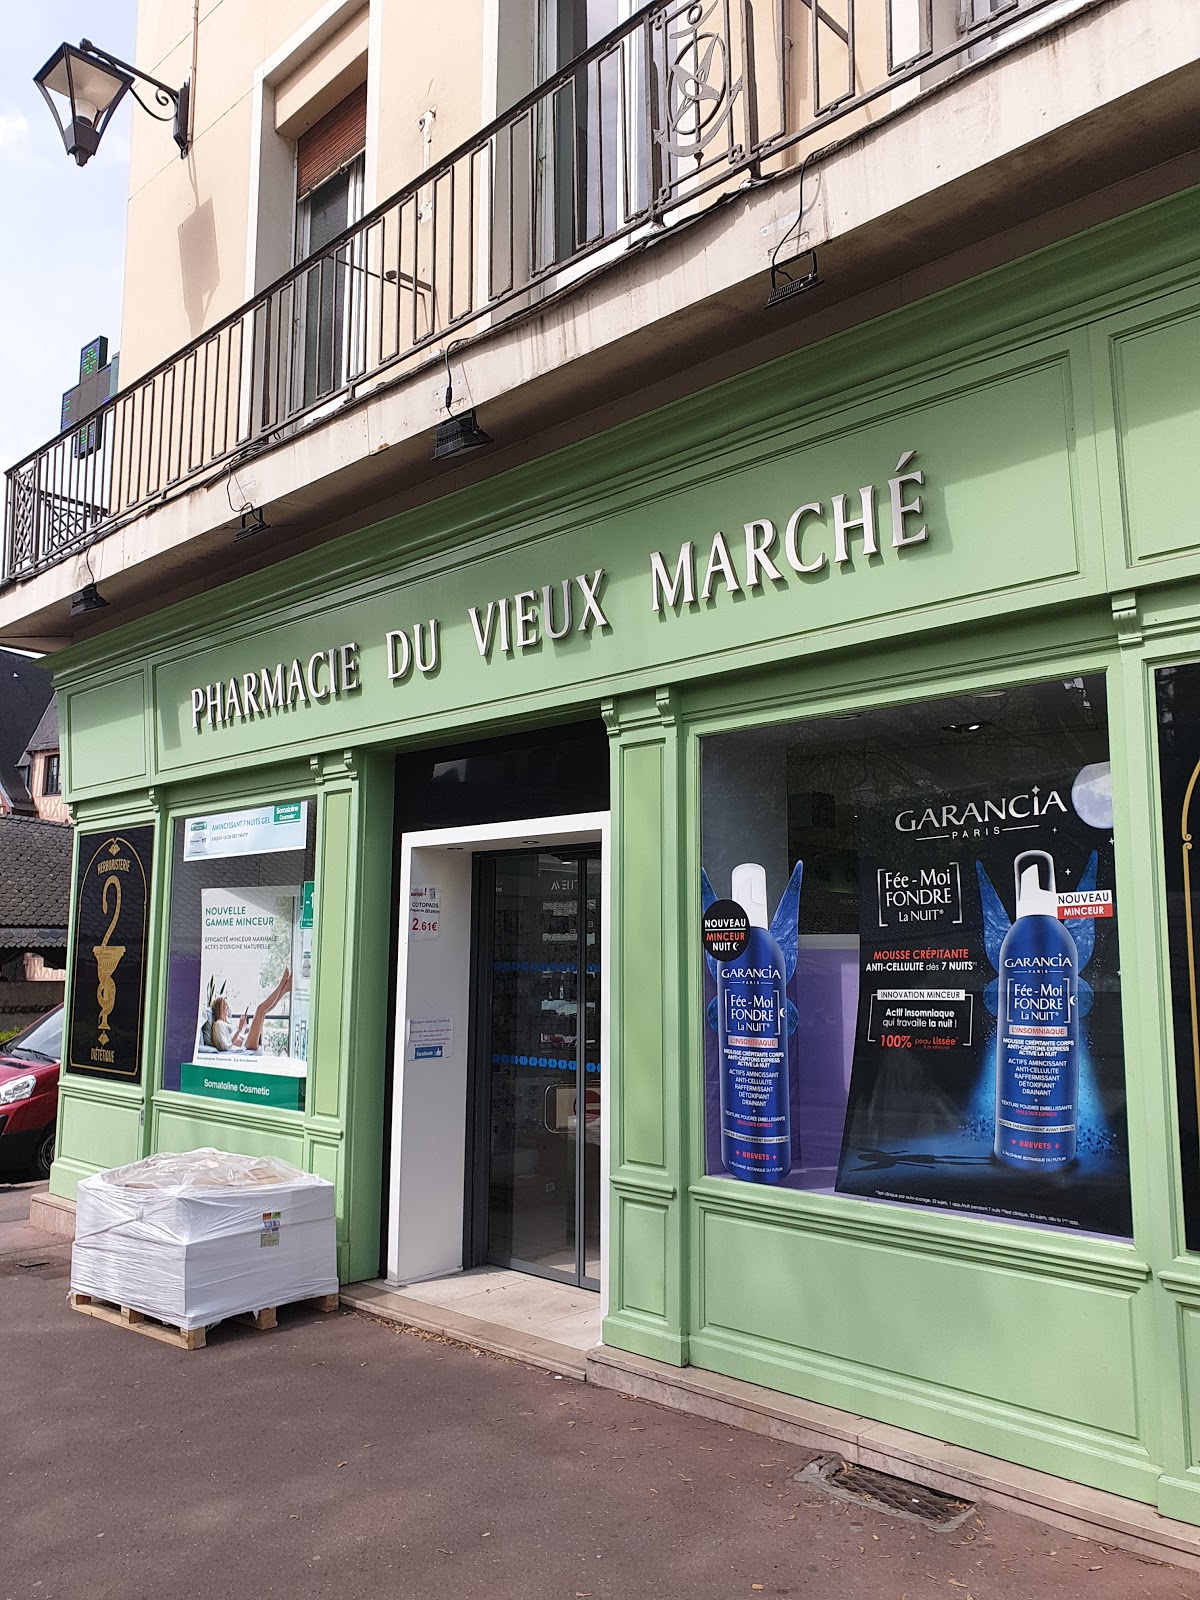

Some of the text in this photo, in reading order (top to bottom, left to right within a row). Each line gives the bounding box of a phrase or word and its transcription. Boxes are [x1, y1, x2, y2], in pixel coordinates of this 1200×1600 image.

[190, 449, 929, 729] PHARMACIE DU VIEUX MARCHÉ
[261, 816, 271, 825] GEL
[951, 825, 1001, 839] PARIS
[885, 887, 952, 908] FONDRE
[1057, 892, 1109, 904] NOUVEAU
[205, 906, 246, 916] NOUVELLE
[1063, 906, 1105, 916] MINCEUR
[205, 917, 274, 927] GAMME MINCEUR
[412, 918, 438, 931] 2.61€
[704, 918, 746, 928] NOUVEAU
[706, 932, 745, 941] MINCEUR
[712, 942, 730, 951] NUIT
[873, 947, 969, 961] MOUSSE CRÉPITANTE
[865, 962, 924, 971] ANTI-CELLULITE
[925, 962, 939, 971] dès
[941, 962, 947, 970] 7
[880, 991, 961, 999] INNOVATION MINCEUR
[1014, 998, 1063, 1010] FONDRE
[731, 1009, 774, 1022] FONDRE
[885, 1008, 955, 1019] Actif insomniaque
[882, 1018, 895, 1028] qui
[896, 1018, 927, 1027] travaille
[928, 1019, 937, 1028] la
[938, 1019, 953, 1028] nuit
[1012, 1027, 1065, 1035] L'INSOMNIAQUE
[880, 1034, 913, 1049] 100%
[914, 1038, 932, 1046] peau
[91, 1047, 116, 1064] DIÉTÉTIQUE
[1015, 1066, 1059, 1074] ANTI-CELLULITE
[735, 1077, 773, 1085] ANTI-CELLULITE
[1014, 1072, 1061, 1082] RAFFERMISSANT
[204, 1079, 270, 1096] Somatoline Cosmetic
[1018, 1080, 1056, 1089] DÉTOXIFIANT
[1022, 1088, 1052, 1096] DRAINANT
[742, 1099, 767, 1107] DRAINANT
[1019, 1140, 1051, 1150] BREVETS
[742, 1151, 770, 1161] BREVETS
